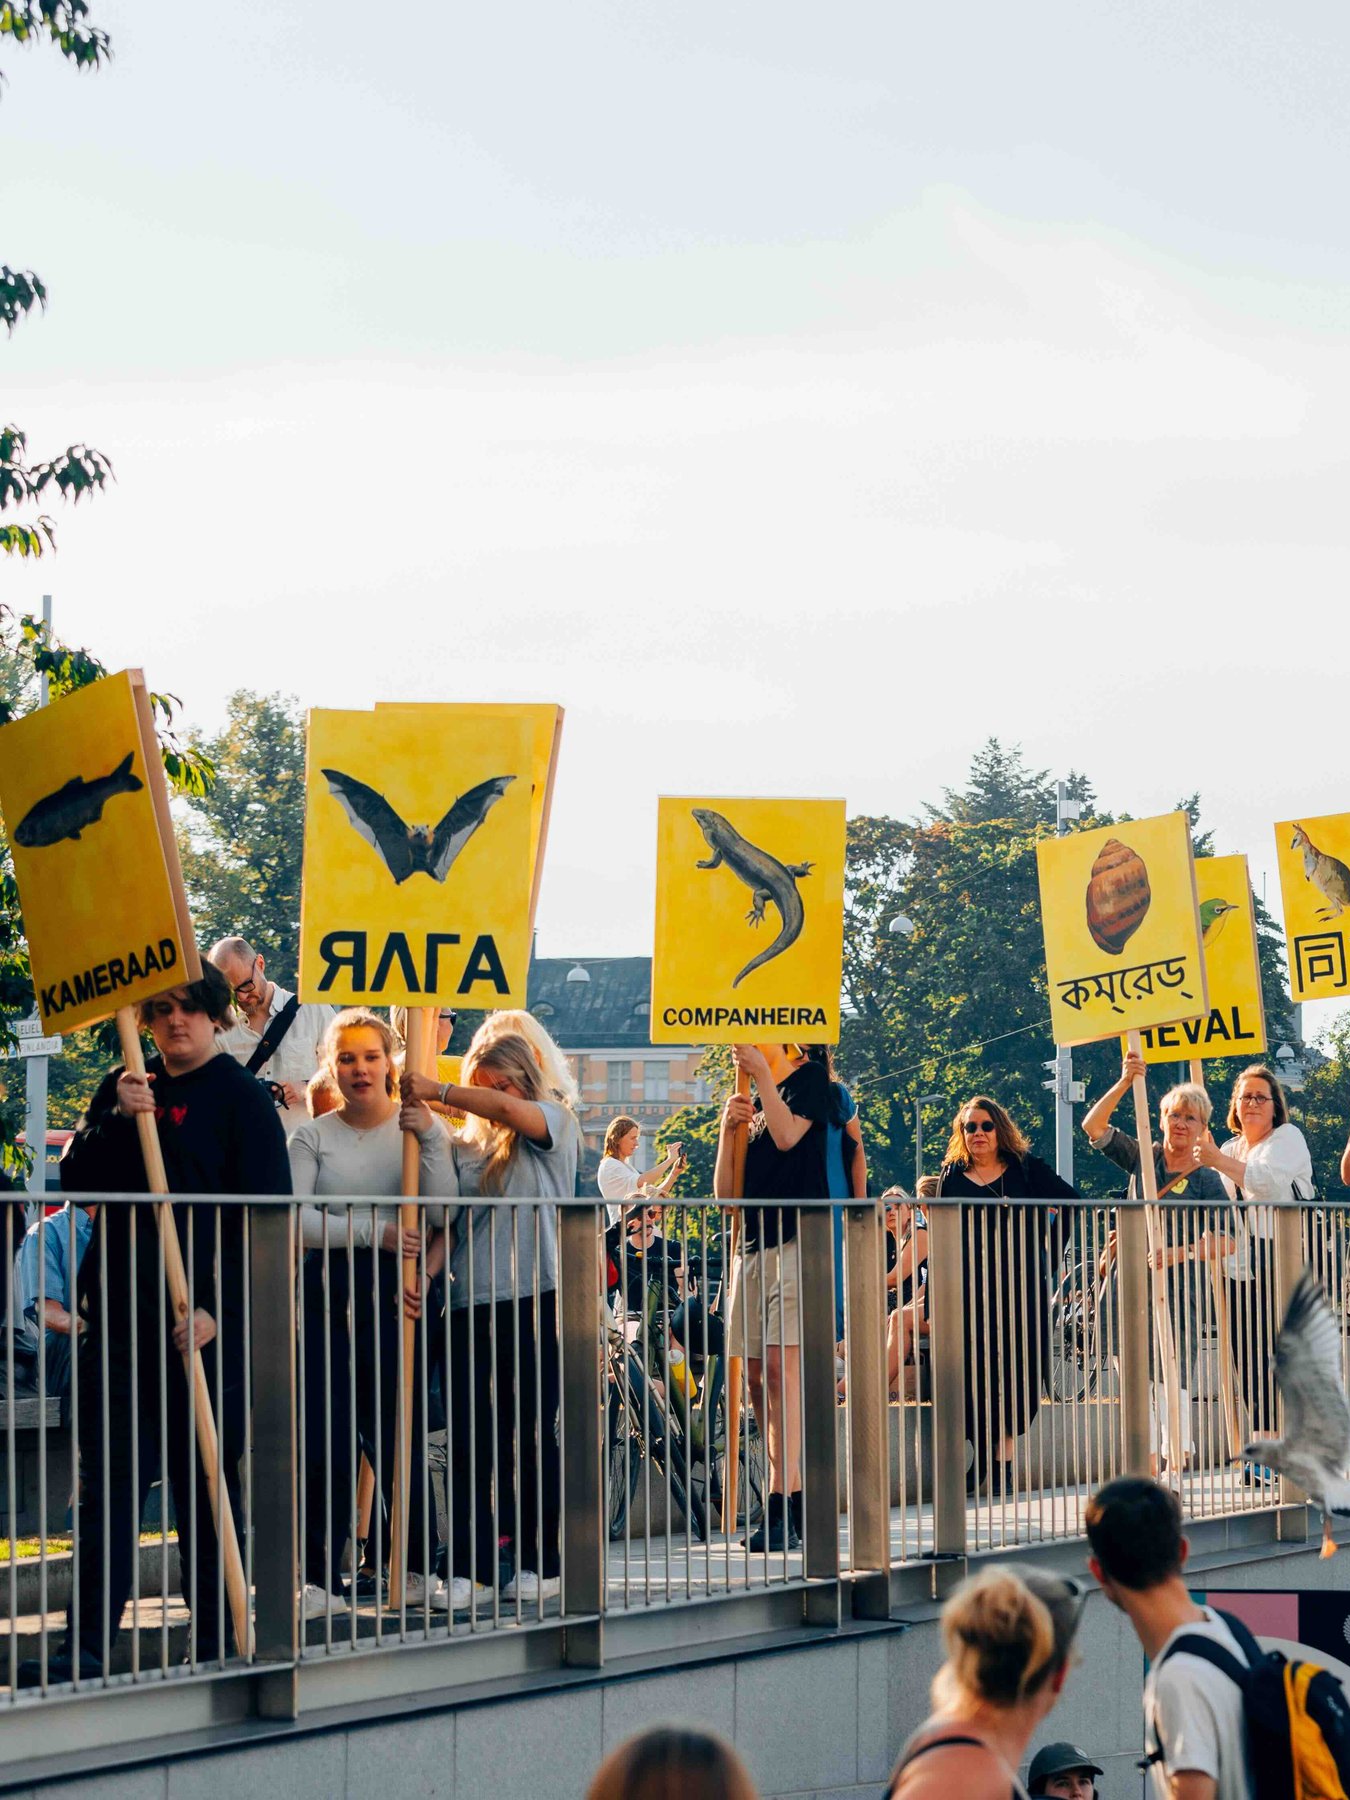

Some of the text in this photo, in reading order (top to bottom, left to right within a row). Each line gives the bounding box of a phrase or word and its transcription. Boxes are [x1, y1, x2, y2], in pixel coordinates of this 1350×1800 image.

[41, 938, 177, 1017] KAMERAAD
[317, 930, 511, 995] ЯЛГА
[662, 1007, 828, 1026] COMPANHEIRA
